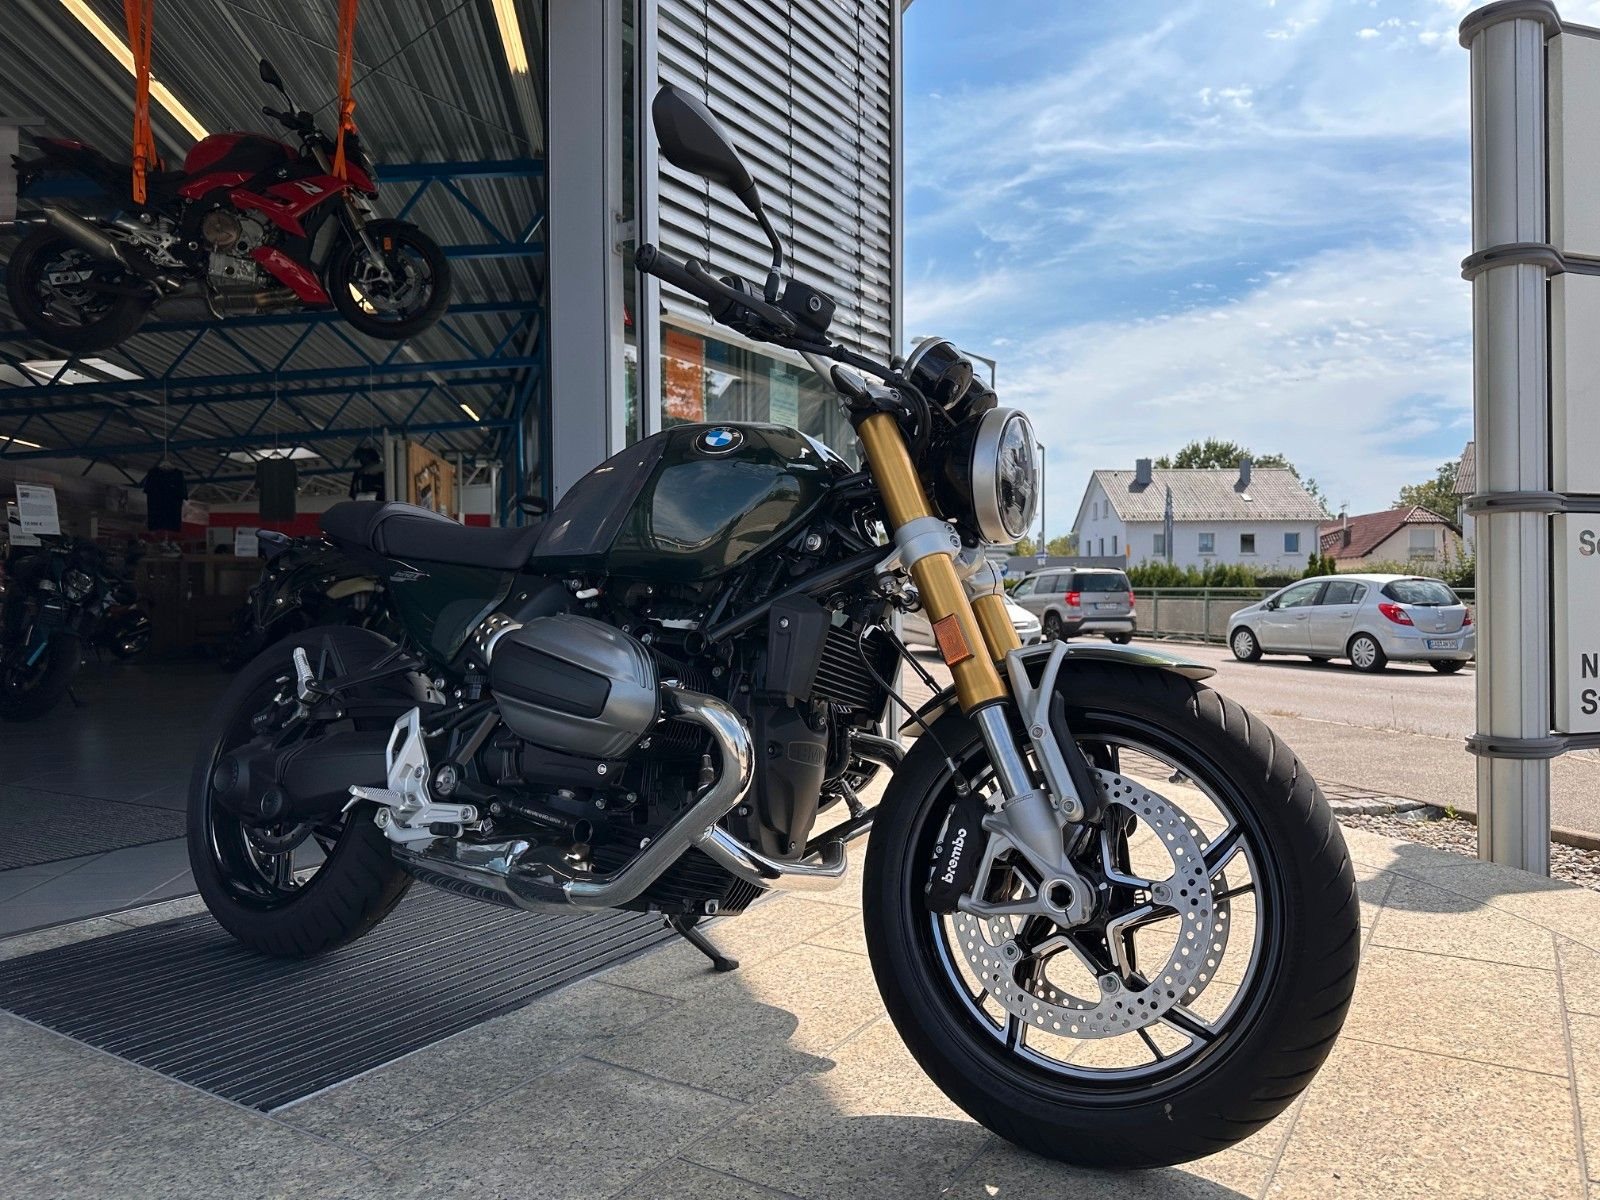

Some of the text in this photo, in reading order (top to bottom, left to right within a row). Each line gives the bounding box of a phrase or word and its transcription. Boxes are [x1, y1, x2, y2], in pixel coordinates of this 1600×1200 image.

[1579, 529, 1600, 556] S
[1581, 689, 1600, 715] S
[941, 828, 967, 883] brembo
